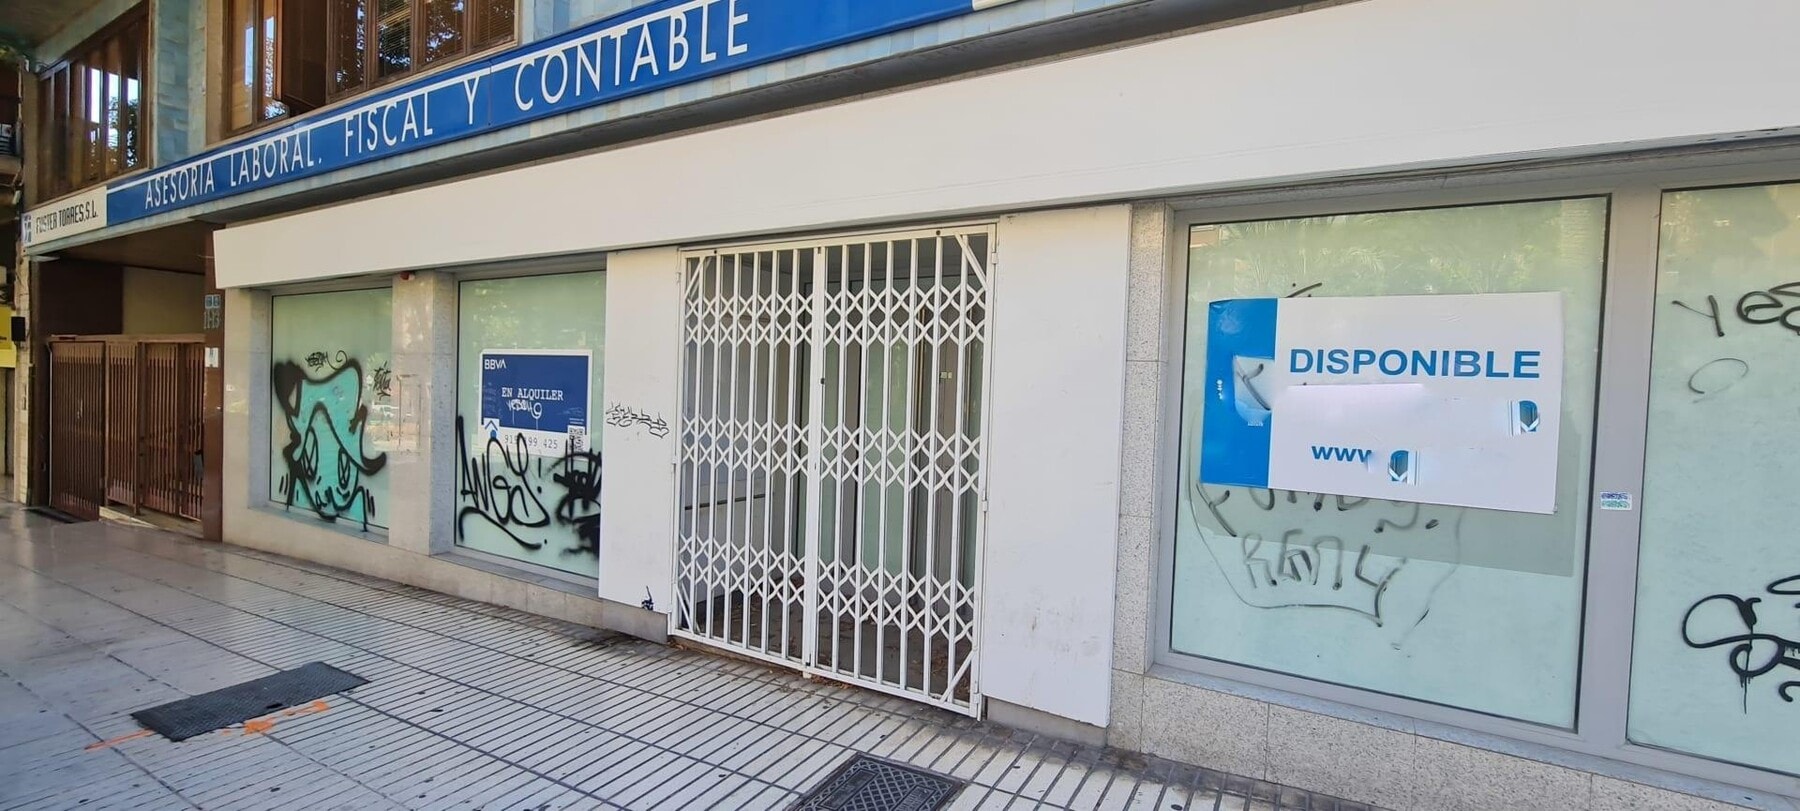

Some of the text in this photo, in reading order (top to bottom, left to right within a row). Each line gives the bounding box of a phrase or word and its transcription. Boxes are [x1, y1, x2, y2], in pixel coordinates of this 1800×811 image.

[345, 91, 433, 156] FISCAL
[463, 74, 480, 125] Y
[514, 0, 749, 111] CONTABLE
[36, 211, 58, 234] FUSTER
[484, 359, 507, 370] BBVA
[1289, 348, 1541, 379] DISPONIBLE
[501, 387, 564, 401] EN ALQUILER
[543, 439, 558, 449] 425
